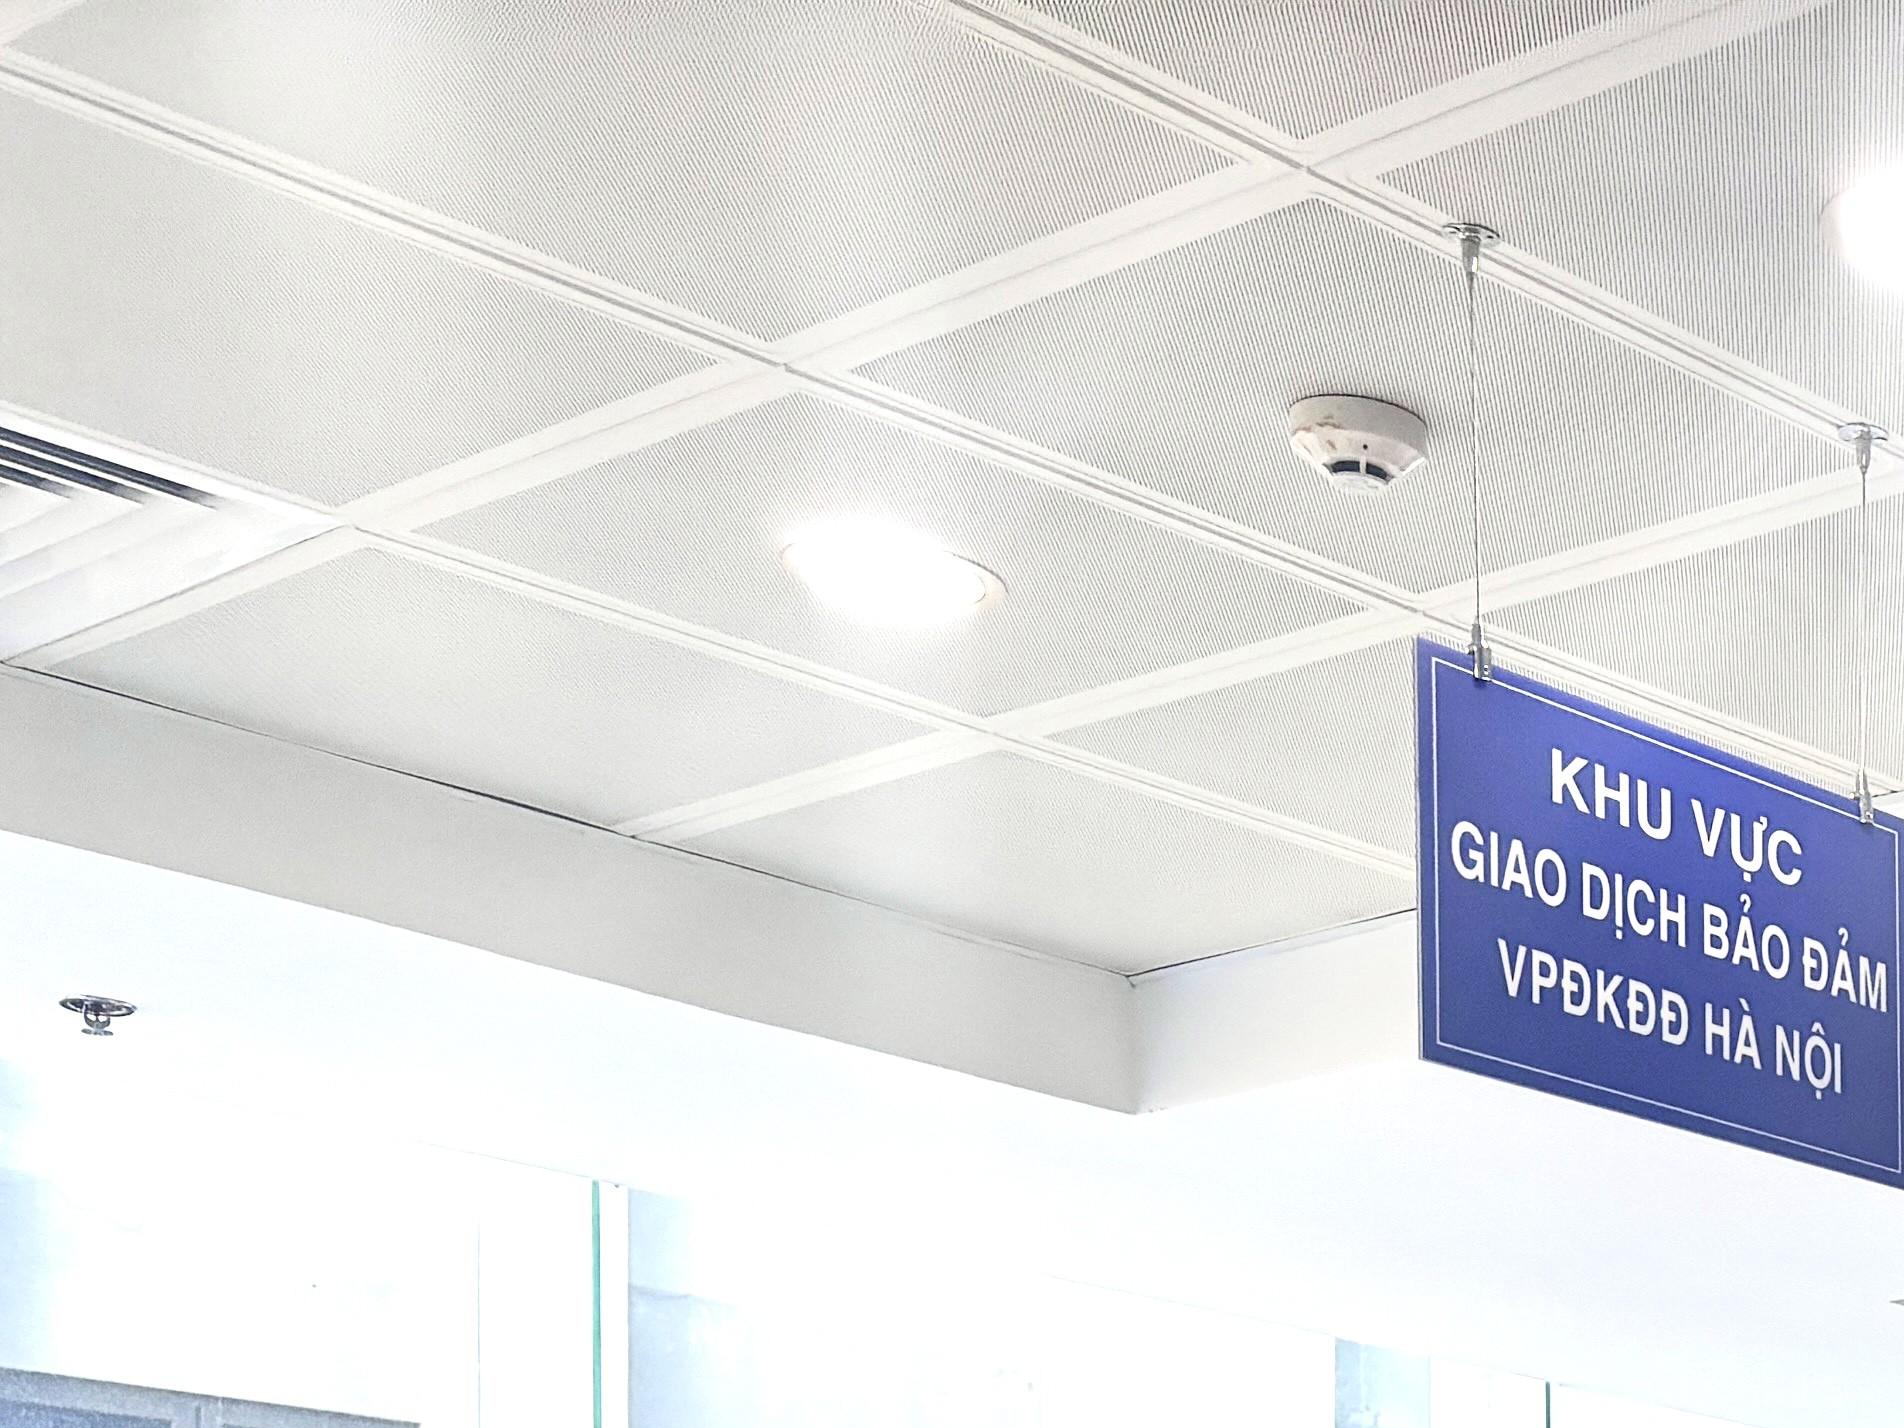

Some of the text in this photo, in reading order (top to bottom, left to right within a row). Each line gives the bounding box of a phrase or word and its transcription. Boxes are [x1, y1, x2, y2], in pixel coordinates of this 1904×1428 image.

[1551, 748, 1802, 886] KHU VỰC
[1451, 821, 1888, 1012] GIAO DỊCH BẢO ĐẢM
[1497, 938, 1843, 1100] VPĐKĐĐ HÀ NỘI
